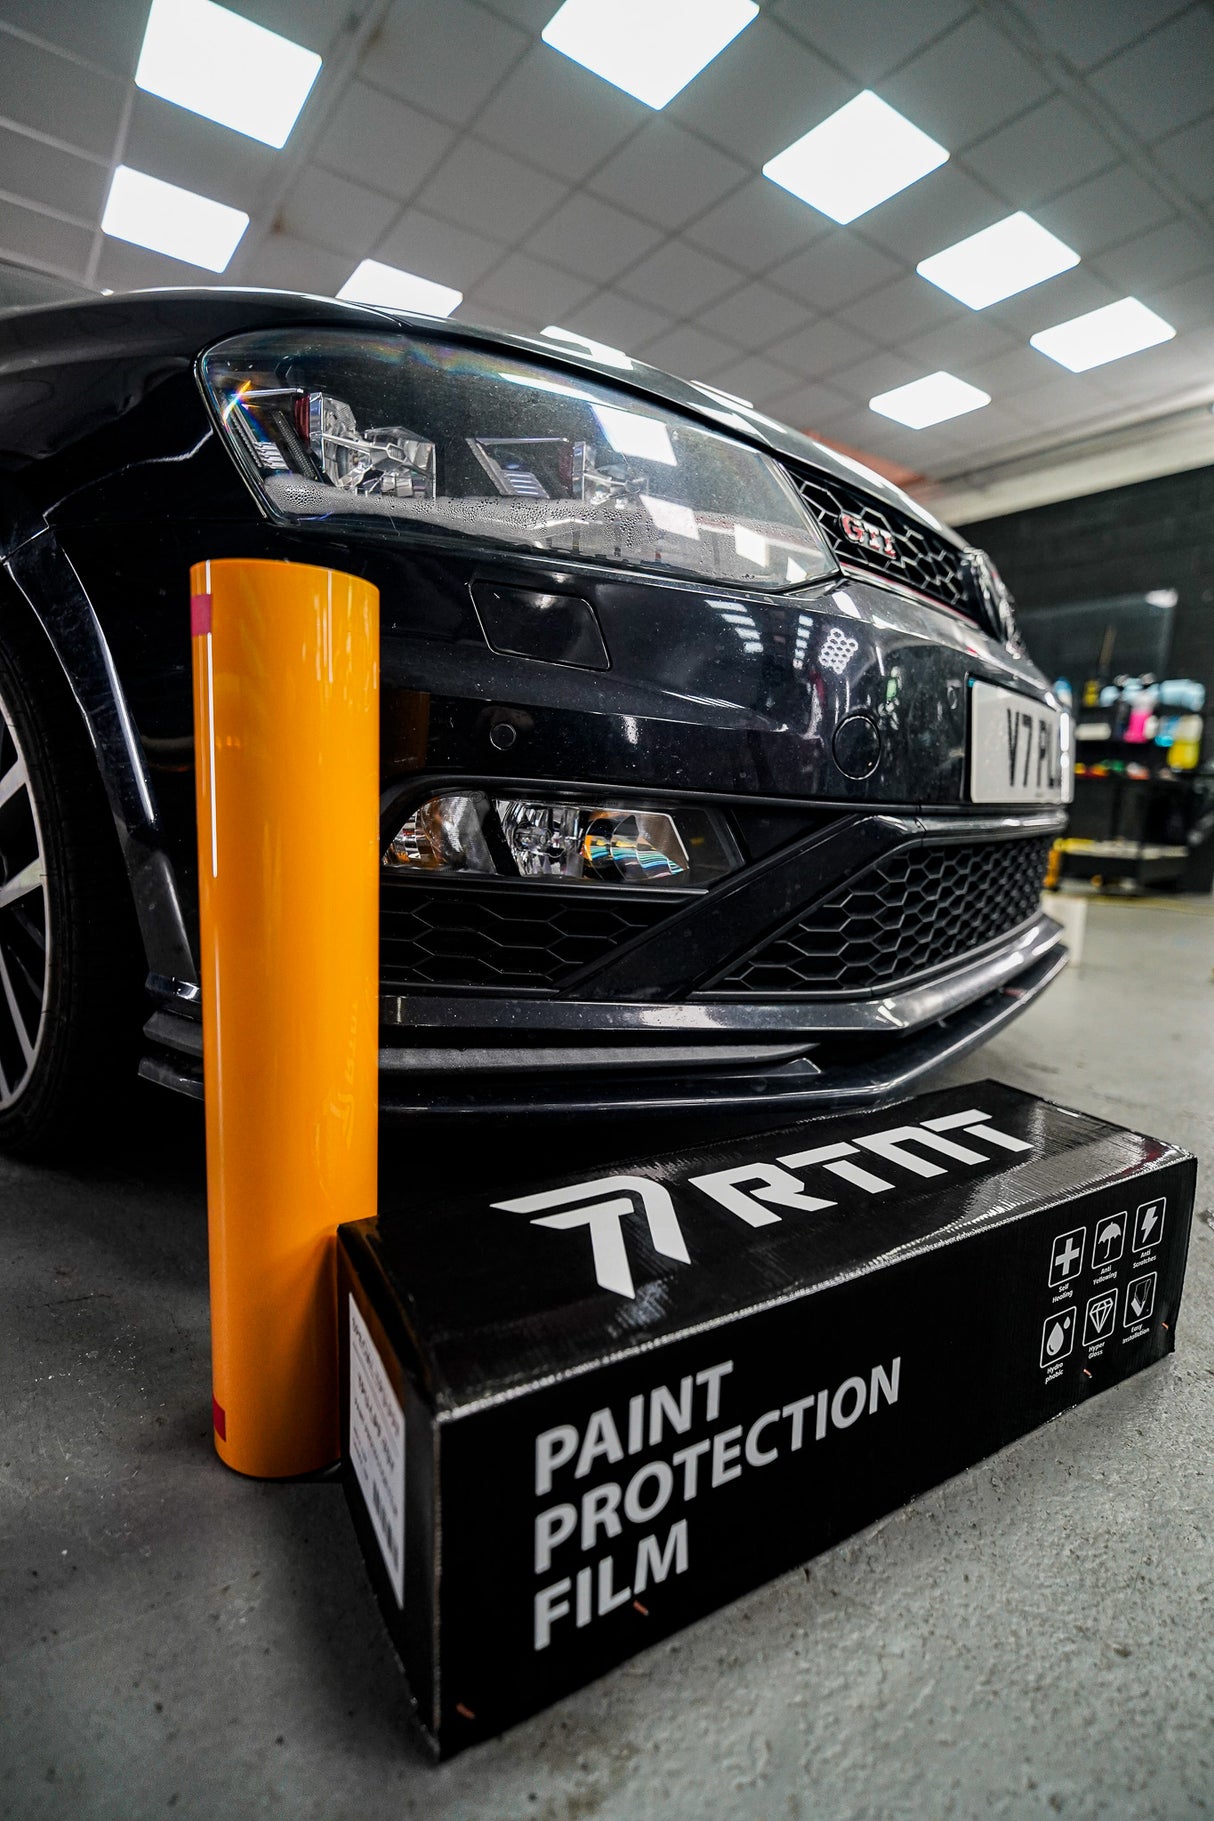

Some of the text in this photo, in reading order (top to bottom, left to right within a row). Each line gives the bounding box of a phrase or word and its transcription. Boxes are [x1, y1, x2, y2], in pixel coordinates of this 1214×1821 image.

[841, 514, 897, 559] GTI
[1007, 708, 1062, 788] V7PL
[1140, 1249, 1151, 1259] Anti
[1100, 1264, 1112, 1275] Anti
[1132, 1255, 1157, 1269] Scratches
[1093, 1271, 1118, 1286] Yellowing
[1058, 1282, 1070, 1293] Self
[1052, 1289, 1073, 1304] Healing
[1088, 1349, 1104, 1360] Gloss
[1046, 1362, 1064, 1375] Hydro
[535, 1360, 733, 1497] PAINT
[535, 1356, 901, 1575] PROTECTION
[534, 1518, 689, 1652] FILM
